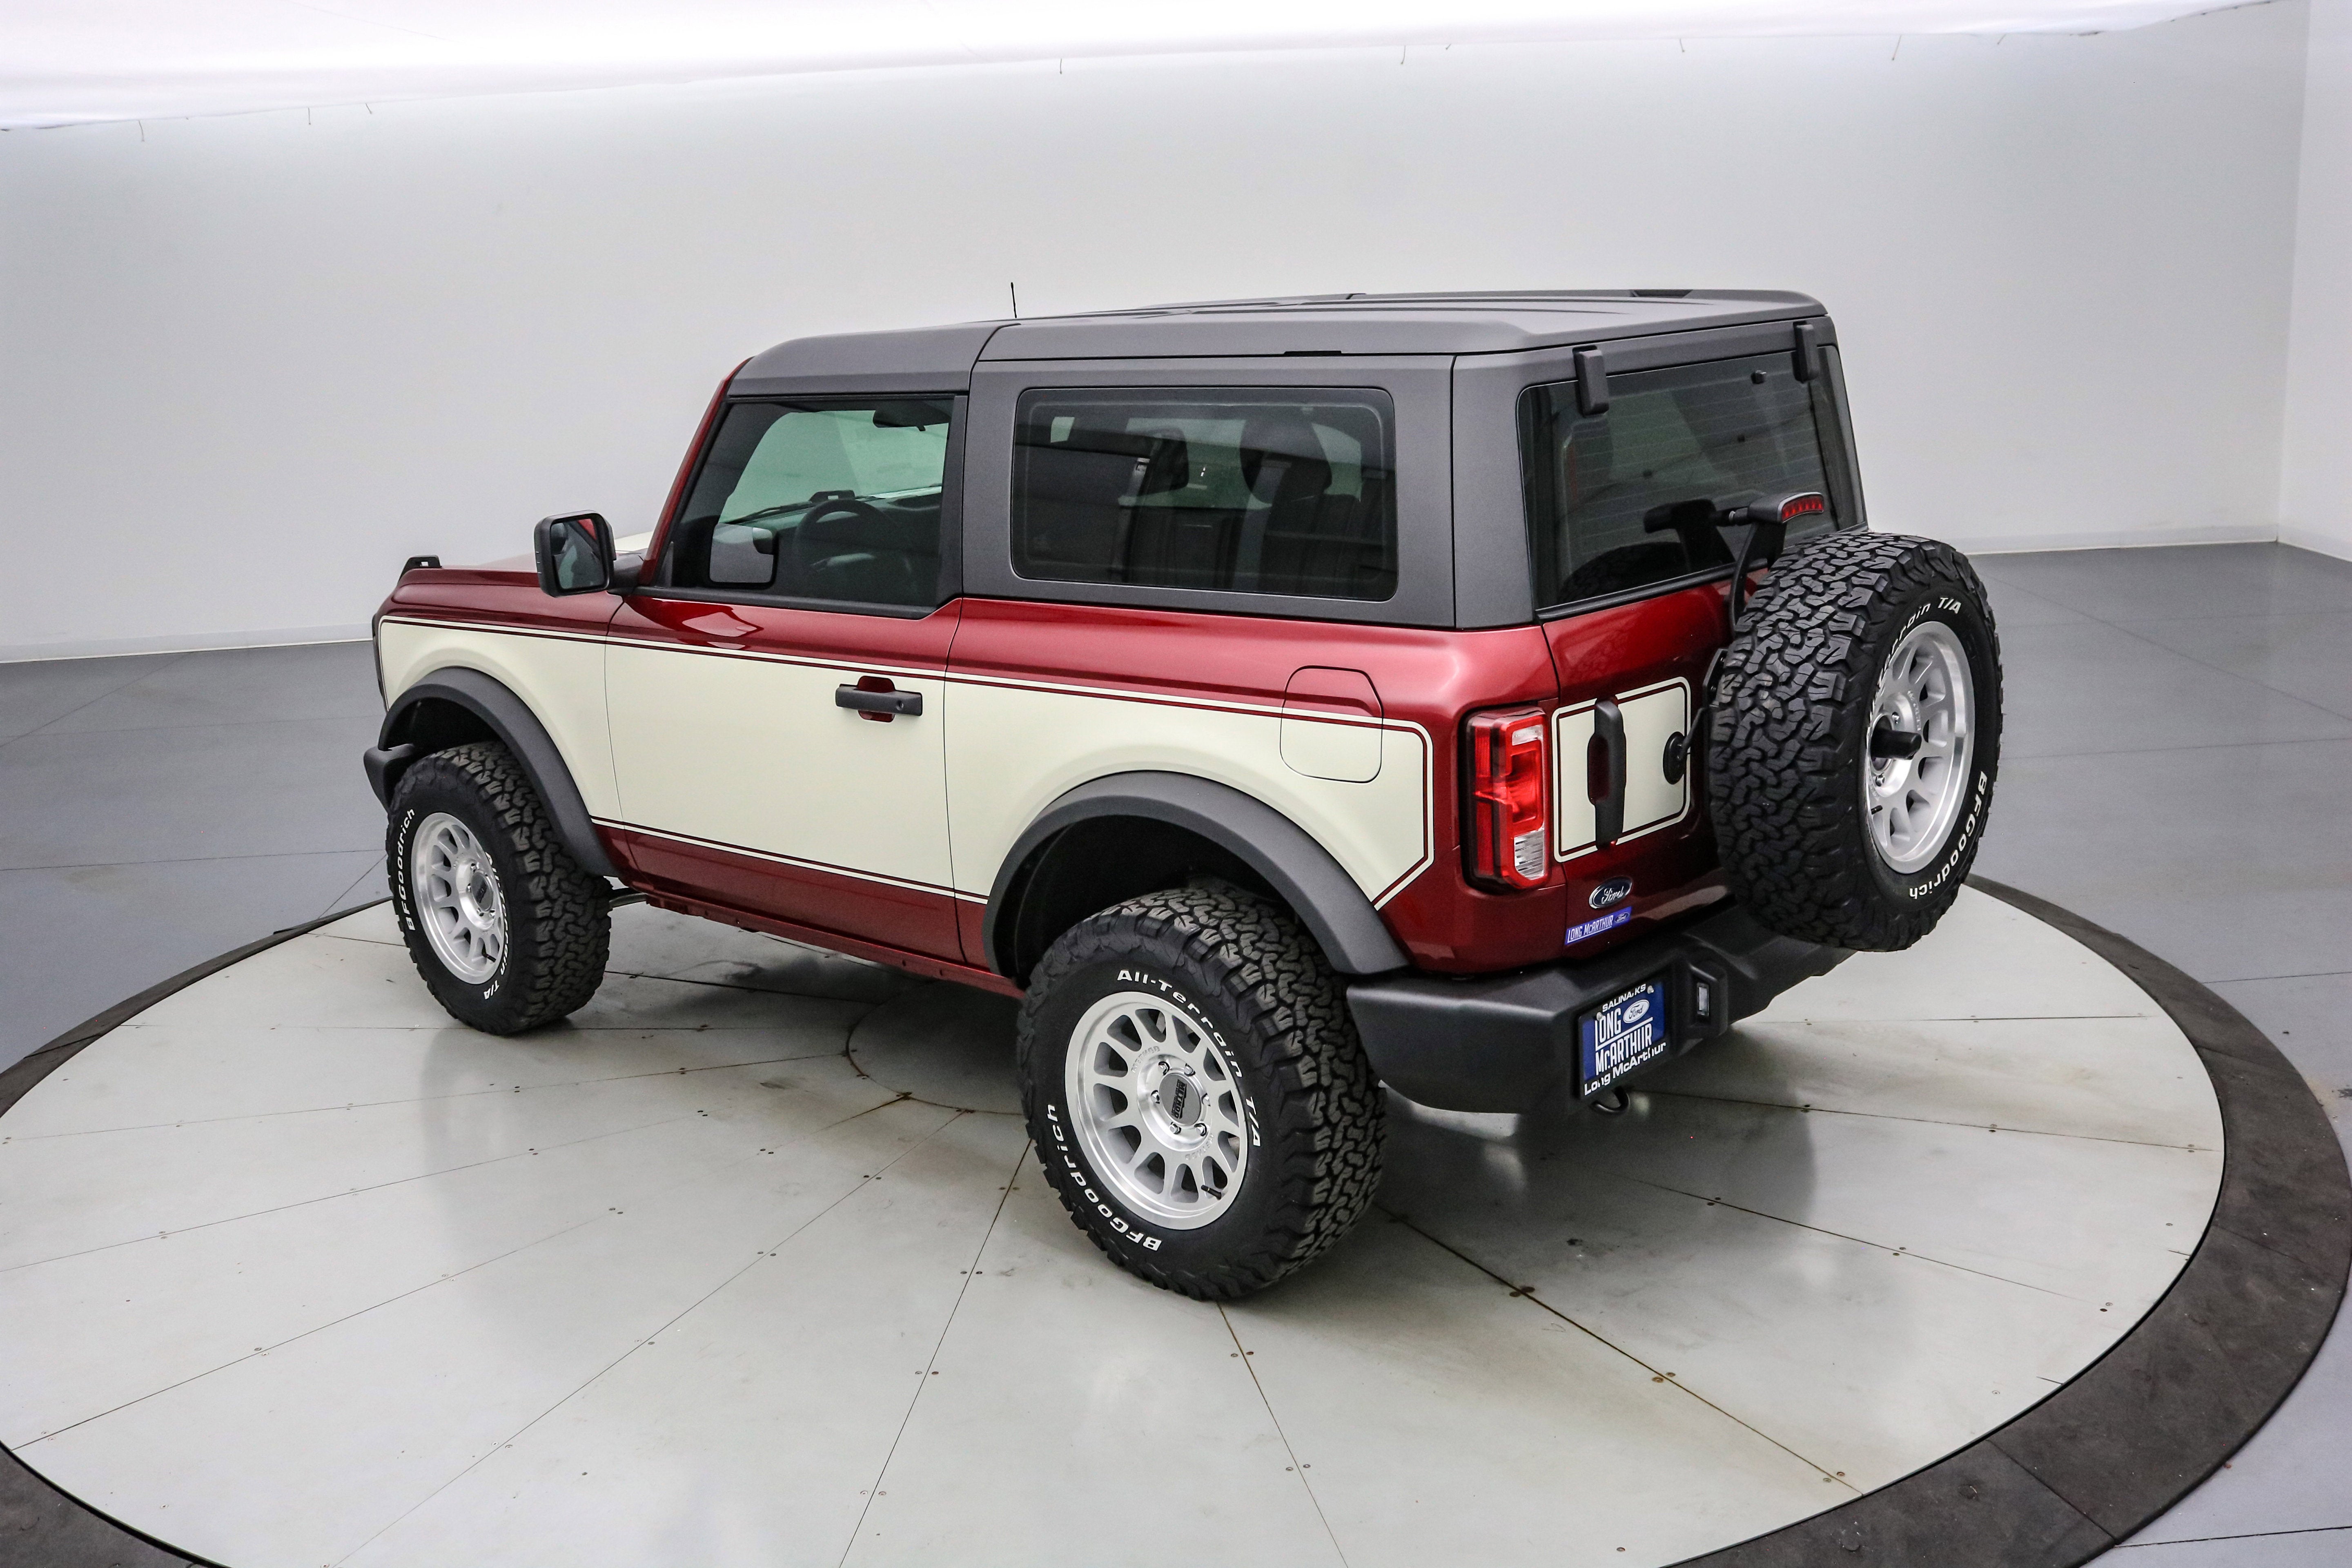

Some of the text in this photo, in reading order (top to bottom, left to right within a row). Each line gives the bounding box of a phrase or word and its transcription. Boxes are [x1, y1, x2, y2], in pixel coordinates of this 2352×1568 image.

[1938, 597, 1961, 613] T/A
[1909, 771, 1987, 899] BFGoodrich
[397, 809, 415, 930] BFGoodrich
[1601, 886, 1624, 904] Ford
[1567, 915, 1614, 943] LONG McARTHUR
[483, 980, 499, 1000] T/A
[1634, 984, 1646, 996] KS
[1628, 1004, 1644, 1019] Ford
[1595, 1008, 1621, 1051] LONG
[1117, 969, 1261, 1147] All-Terrain T/A
[1131, 1046, 1160, 1074] METHOD
[1584, 1042, 1666, 1096] Long McArthur
[1175, 1082, 1186, 1119] METHOD
[1047, 1104, 1162, 1251] BFGoodrich
